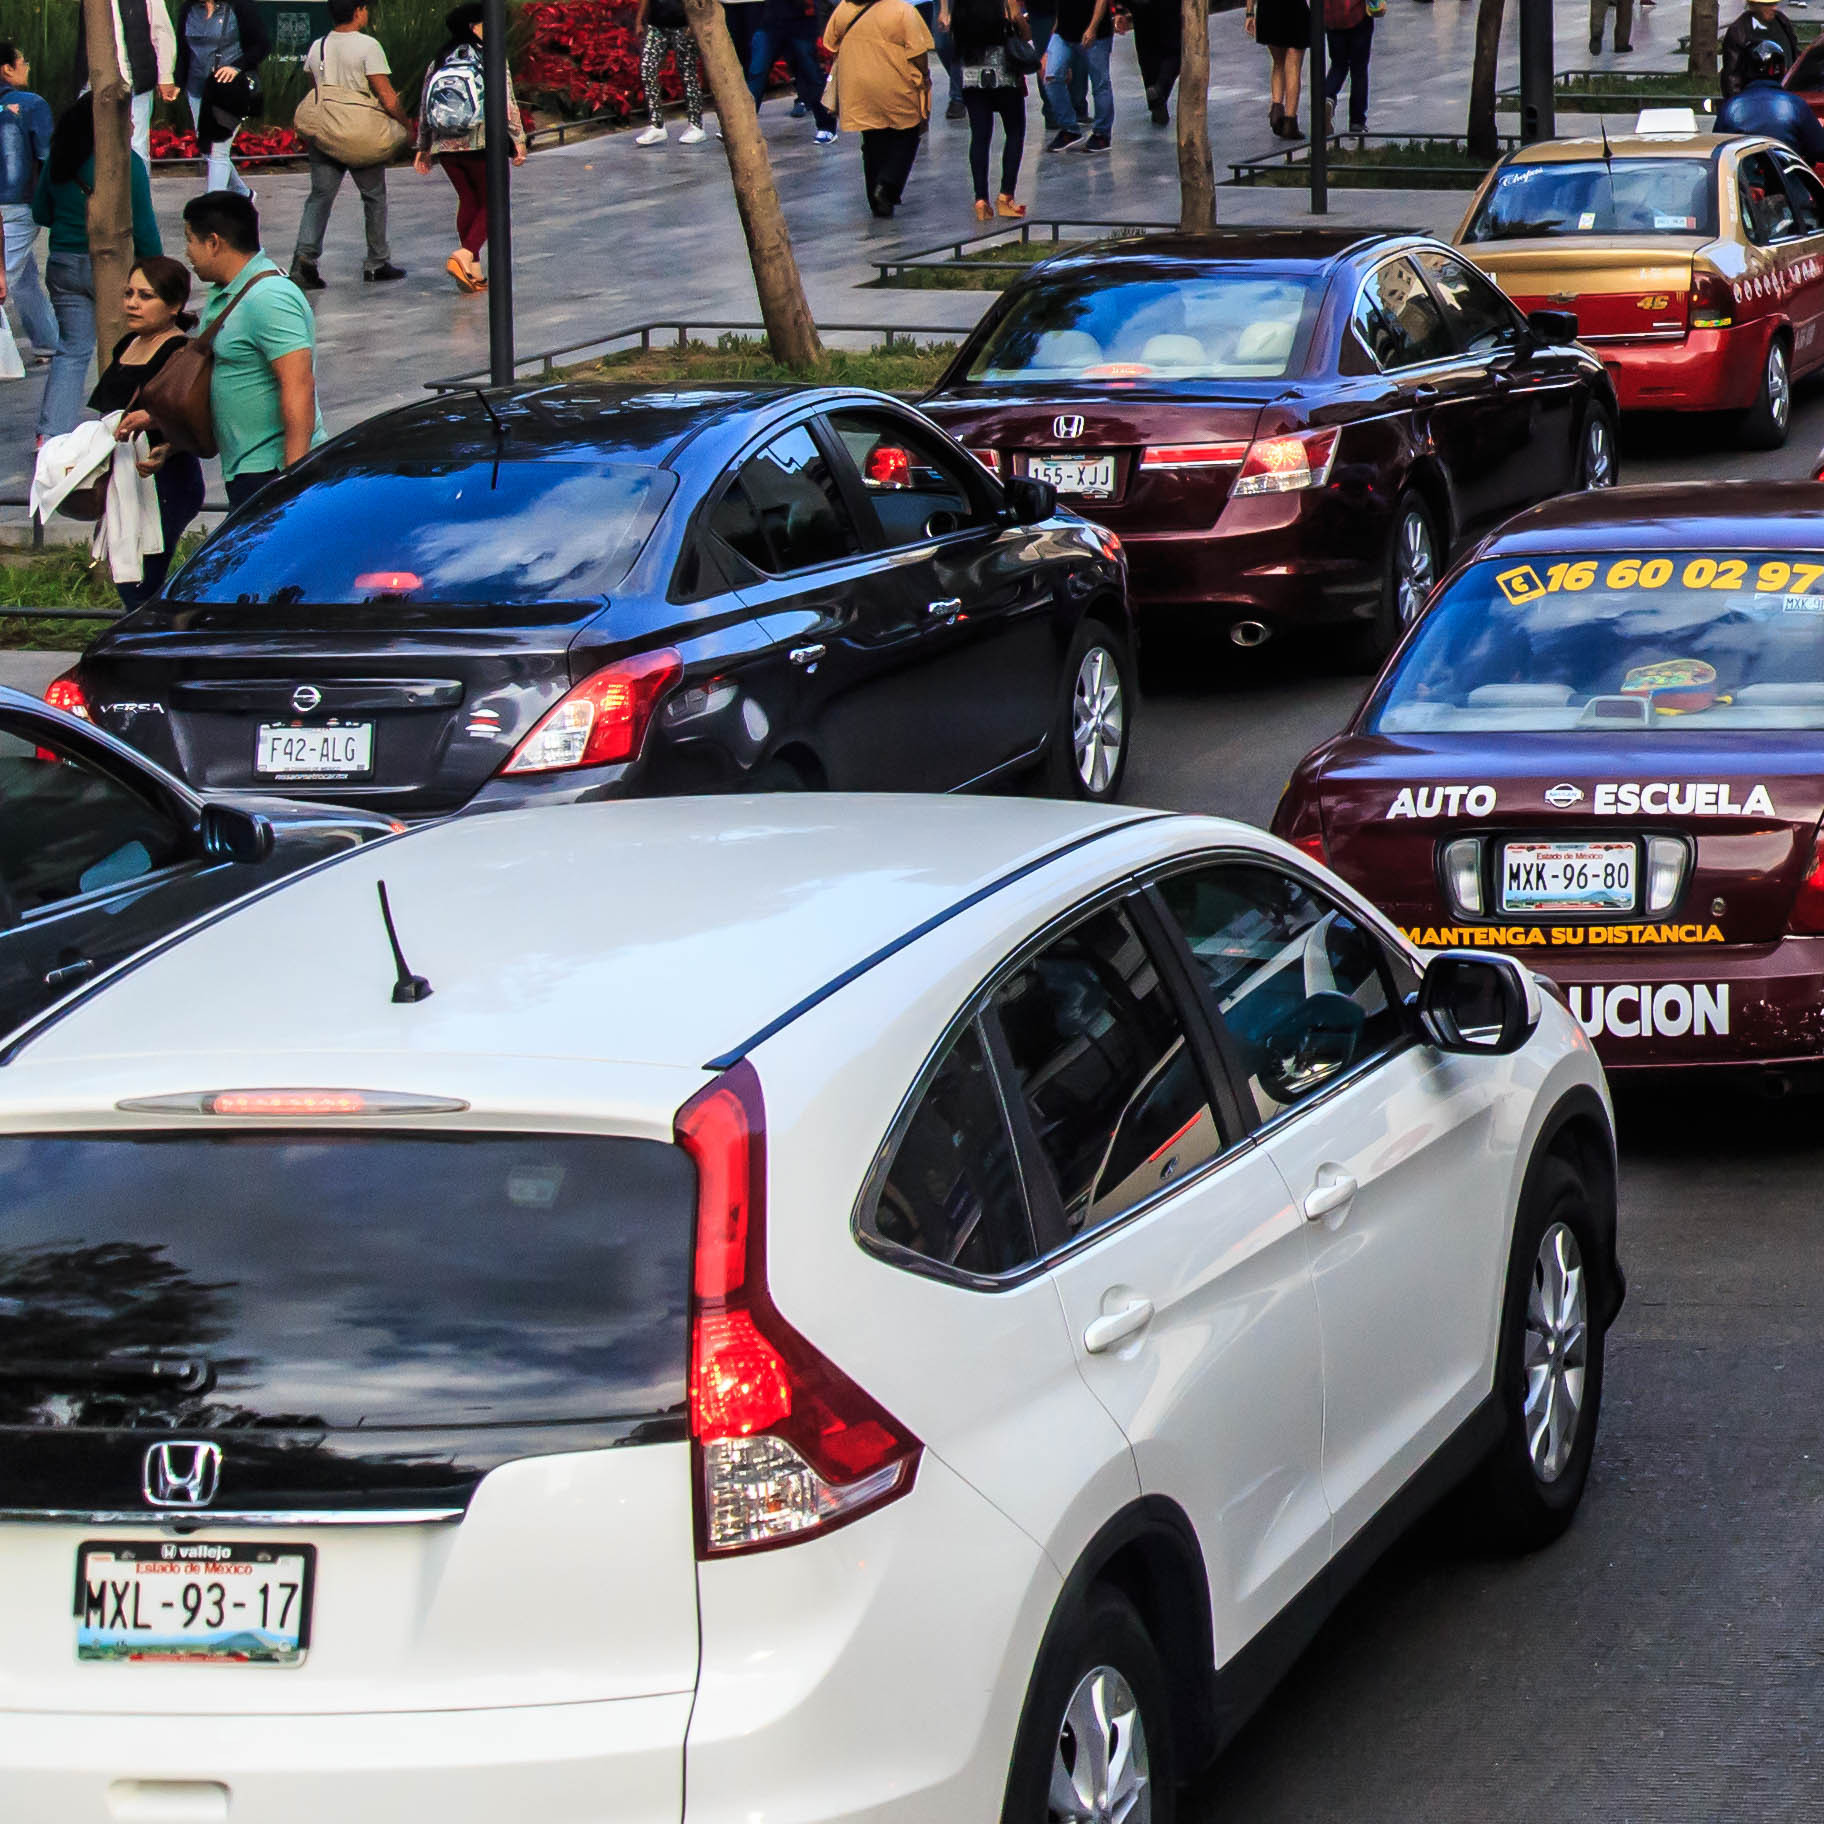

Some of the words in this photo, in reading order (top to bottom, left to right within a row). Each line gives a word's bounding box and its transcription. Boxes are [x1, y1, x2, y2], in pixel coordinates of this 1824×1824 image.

[1033, 465, 1109, 486] 155-XJJ
[1546, 560, 1599, 593] 16
[1606, 559, 1674, 590] 60
[1682, 559, 1748, 590] 02
[1755, 561, 1824, 594] 97
[100, 702, 165, 714] VERSA
[271, 736, 356, 763] F42-ALG
[1386, 784, 1497, 820] AUTO
[1593, 783, 1776, 817] ESCUELA
[1536, 852, 1562, 861] Estado
[1563, 852, 1573, 861] de
[1509, 862, 1629, 892] MXK-96-80
[1399, 927, 1547, 946] MANTENGA
[1551, 926, 1584, 945] SU
[1588, 925, 1725, 944] DISTANCIA
[179, 1545, 232, 1562] vallejo
[136, 1562, 181, 1575] Estado
[184, 1562, 201, 1575] de
[85, 1579, 299, 1630] MXL-93-17
